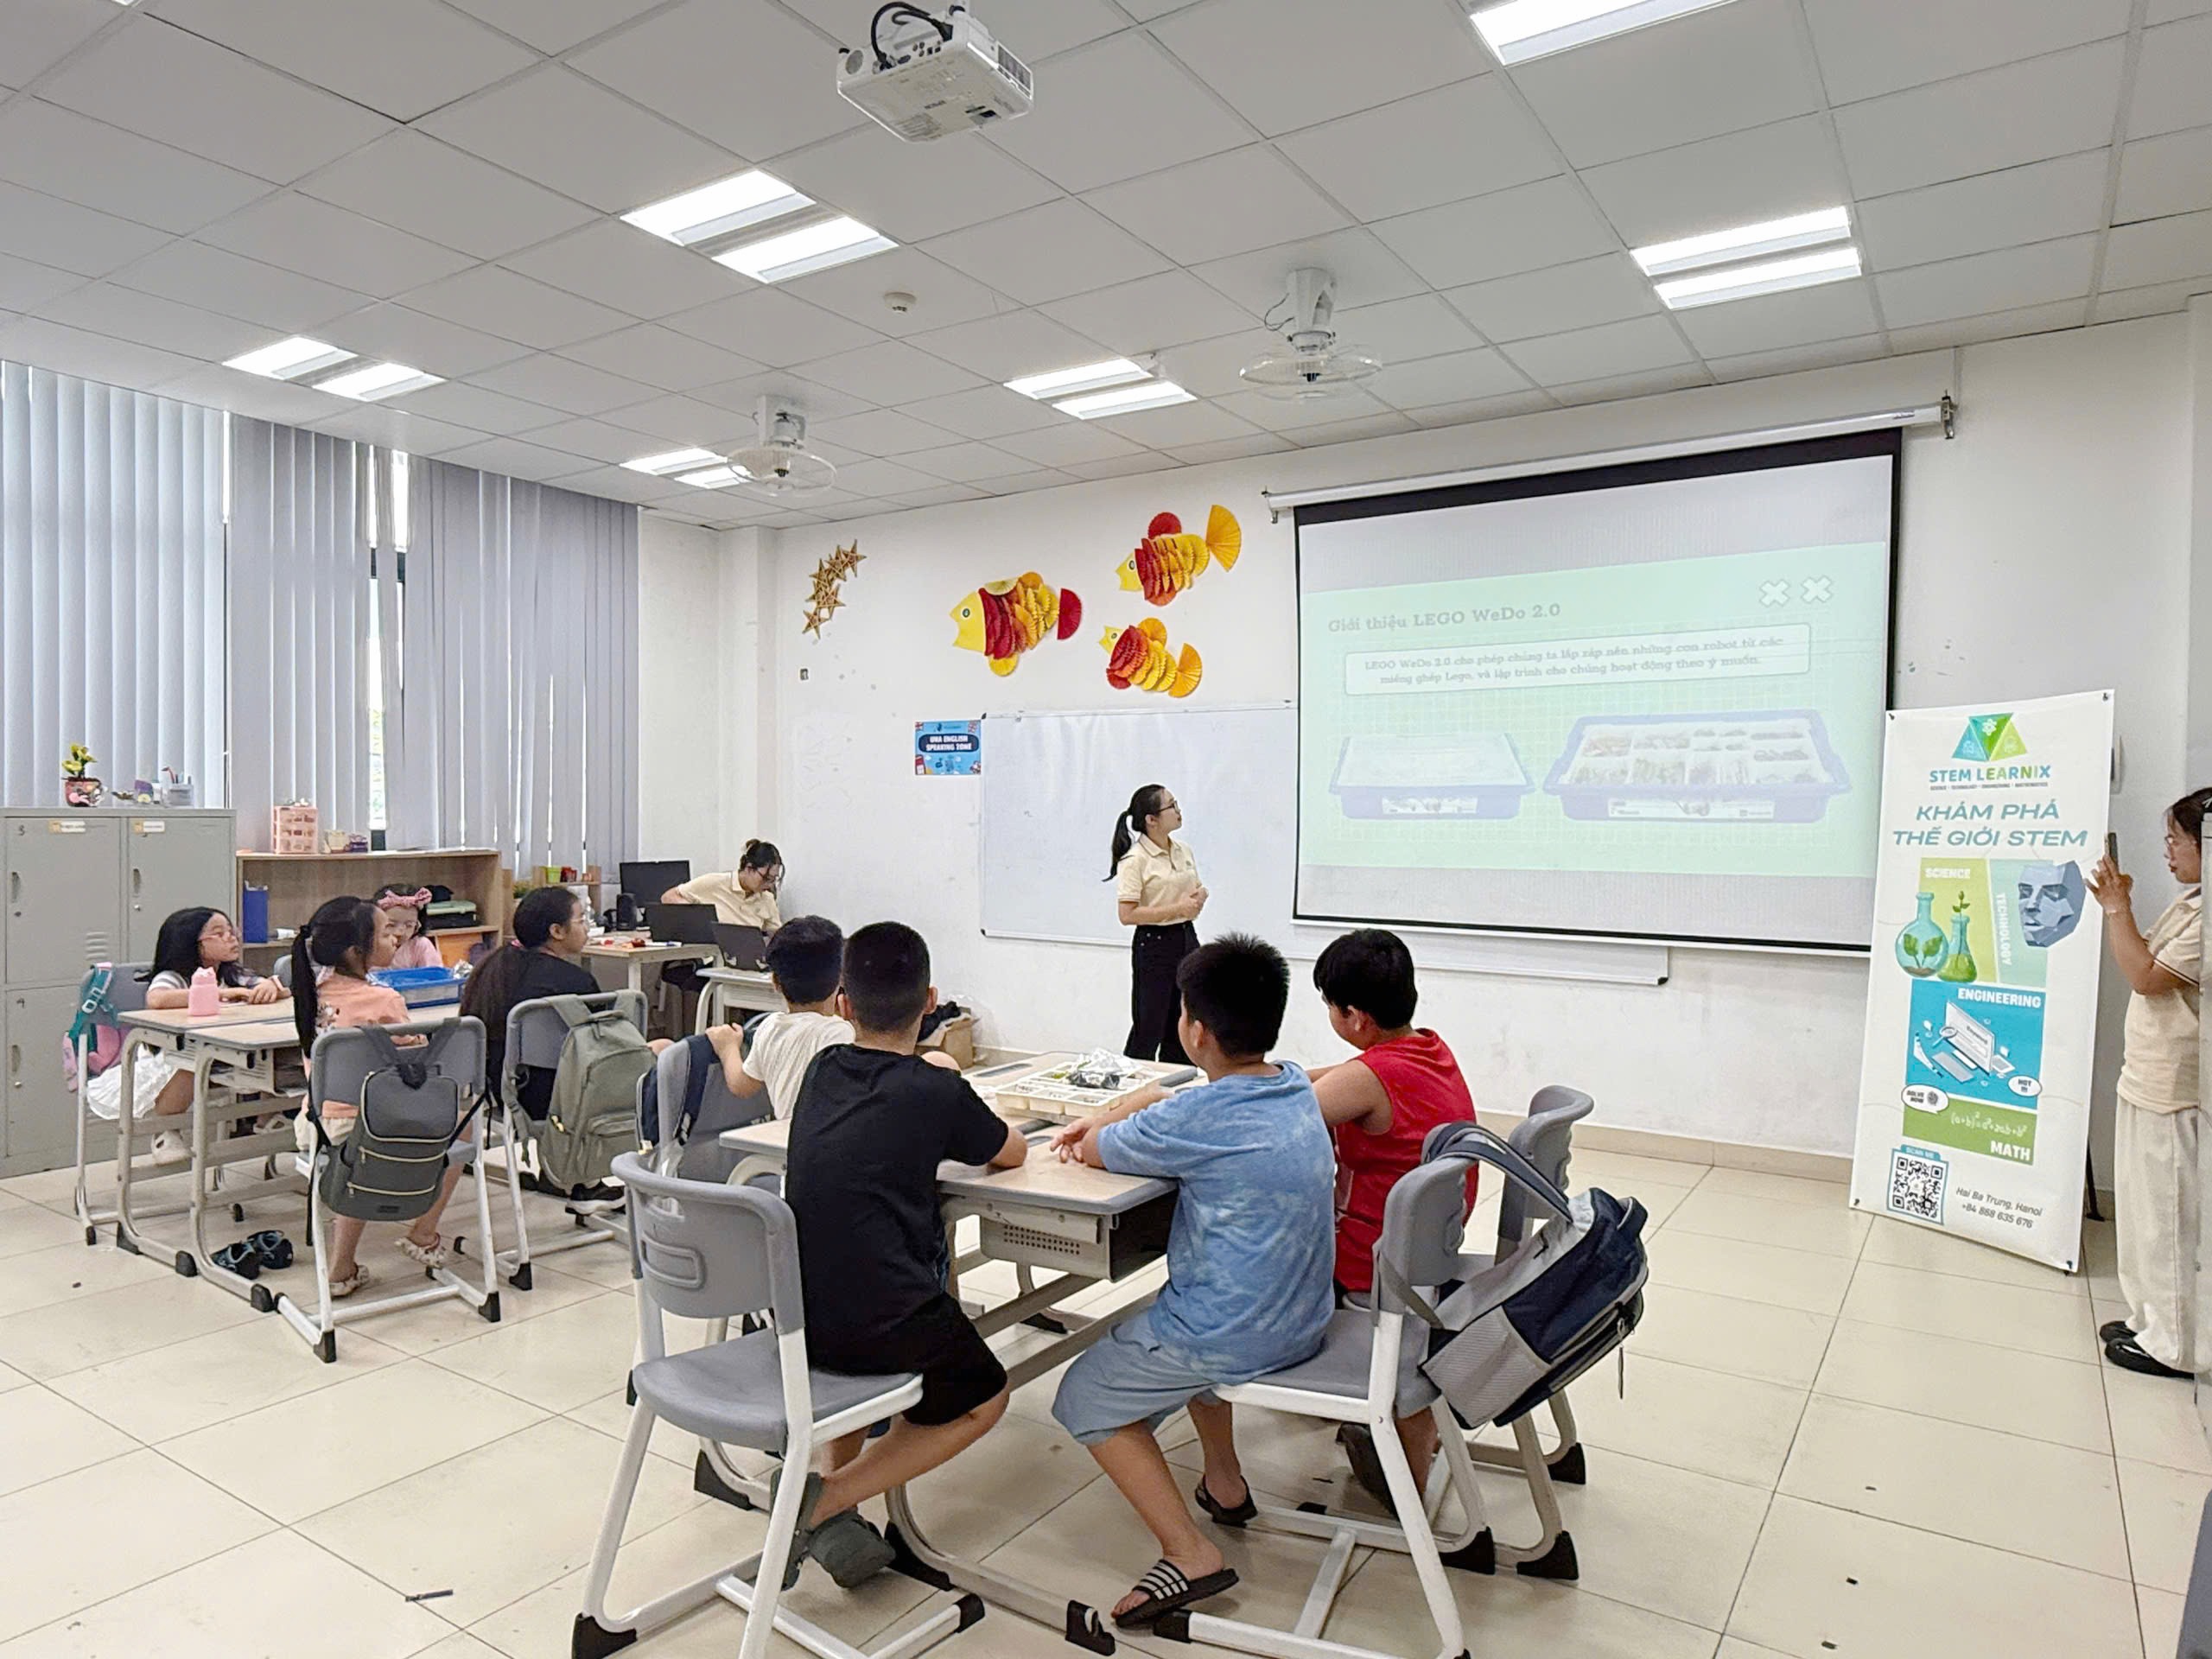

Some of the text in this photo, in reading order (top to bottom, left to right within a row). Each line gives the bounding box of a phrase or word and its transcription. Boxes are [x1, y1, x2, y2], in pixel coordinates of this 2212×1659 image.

[1366, 616, 1407, 632] thiệu
[1414, 611, 1465, 627] LEGO
[1471, 607, 1526, 622] WeDo
[1532, 603, 1561, 619] 2.0
[1400, 658, 1432, 669] WeDo
[1454, 656, 1474, 665] cho
[1547, 652, 1558, 660] ta
[1703, 639, 1738, 651] robot
[1546, 665, 1567, 676] cho
[1676, 657, 1705, 669] theo
[1929, 765, 2051, 784] STEM LEARNIX
[1916, 798, 2060, 821] KHÁM PHÁ
[1893, 826, 2088, 847] THẾ GIỚI STEM
[1924, 868, 1971, 880] SCIENCE
[1996, 893, 2012, 966] TECHNOLOGY
[1957, 988, 2042, 1008] ENGINEERING
[1990, 1141, 2031, 1161] MATH
[1955, 1186, 1971, 1198] Hai
[1972, 1191, 1984, 1201] Ba
[2015, 1202, 2044, 1217] Hanoi
[1961, 1203, 1977, 1213] +84
[1997, 1211, 2015, 1224] 635
[2015, 1216, 2034, 1229] 676
